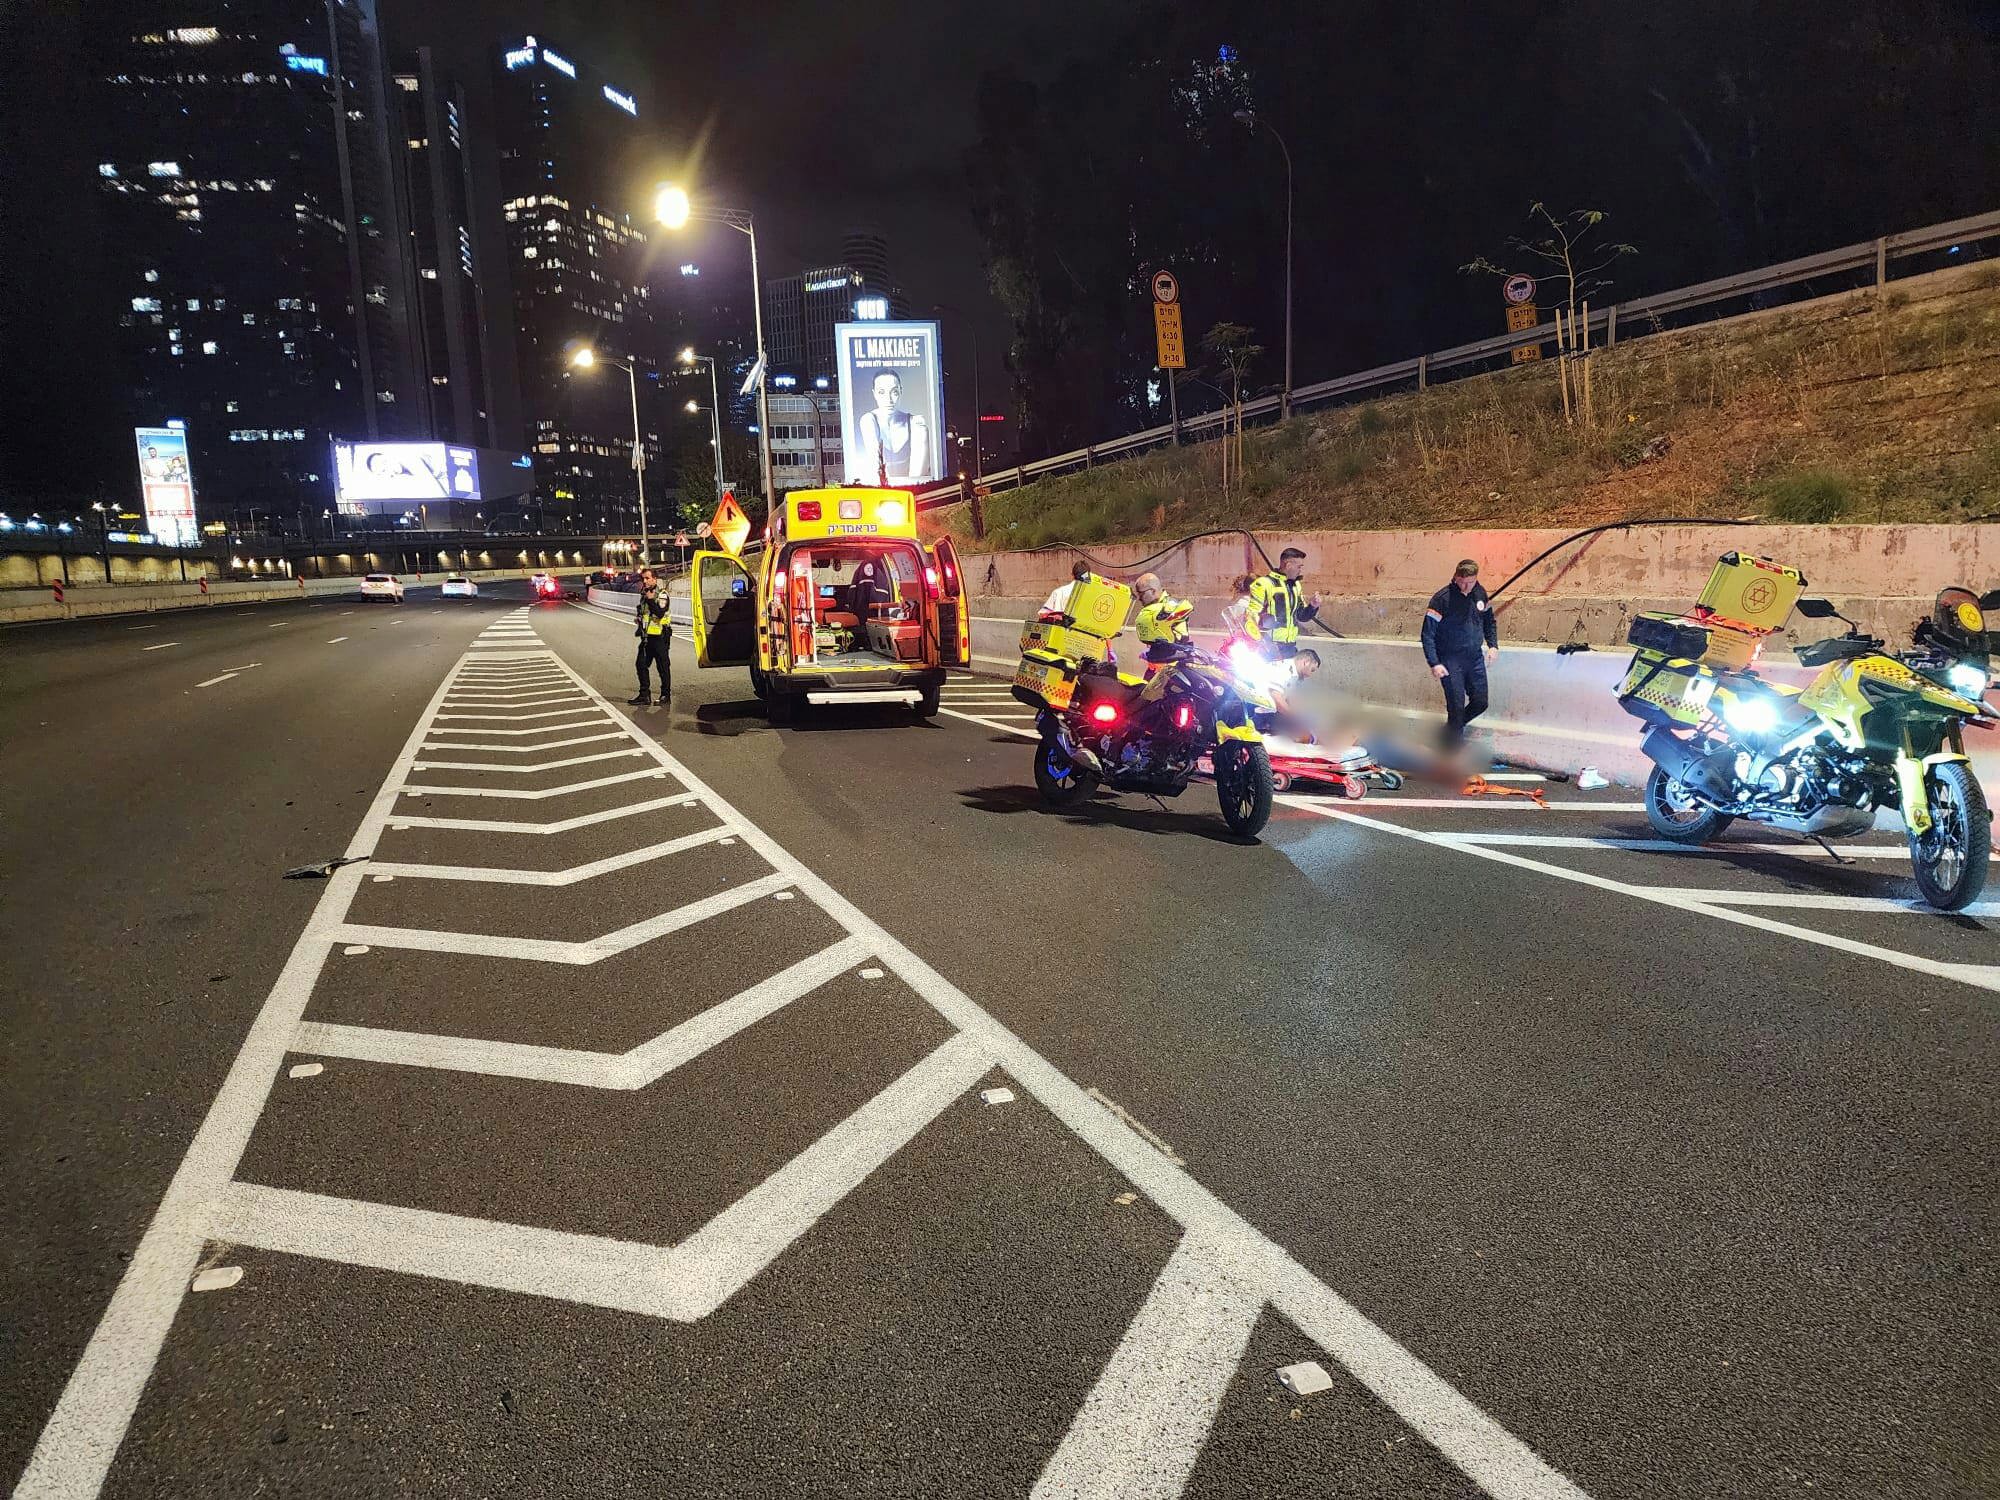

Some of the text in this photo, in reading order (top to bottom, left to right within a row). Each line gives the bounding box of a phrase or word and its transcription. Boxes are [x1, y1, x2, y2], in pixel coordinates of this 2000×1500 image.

[1162, 332, 1178, 340] 6:30
[854, 338, 921, 358] IL MAKIAGE
[1166, 343, 1176, 351] עד
[1163, 354, 1180, 362] 9:30
[828, 523, 878, 535] פראמדיק
